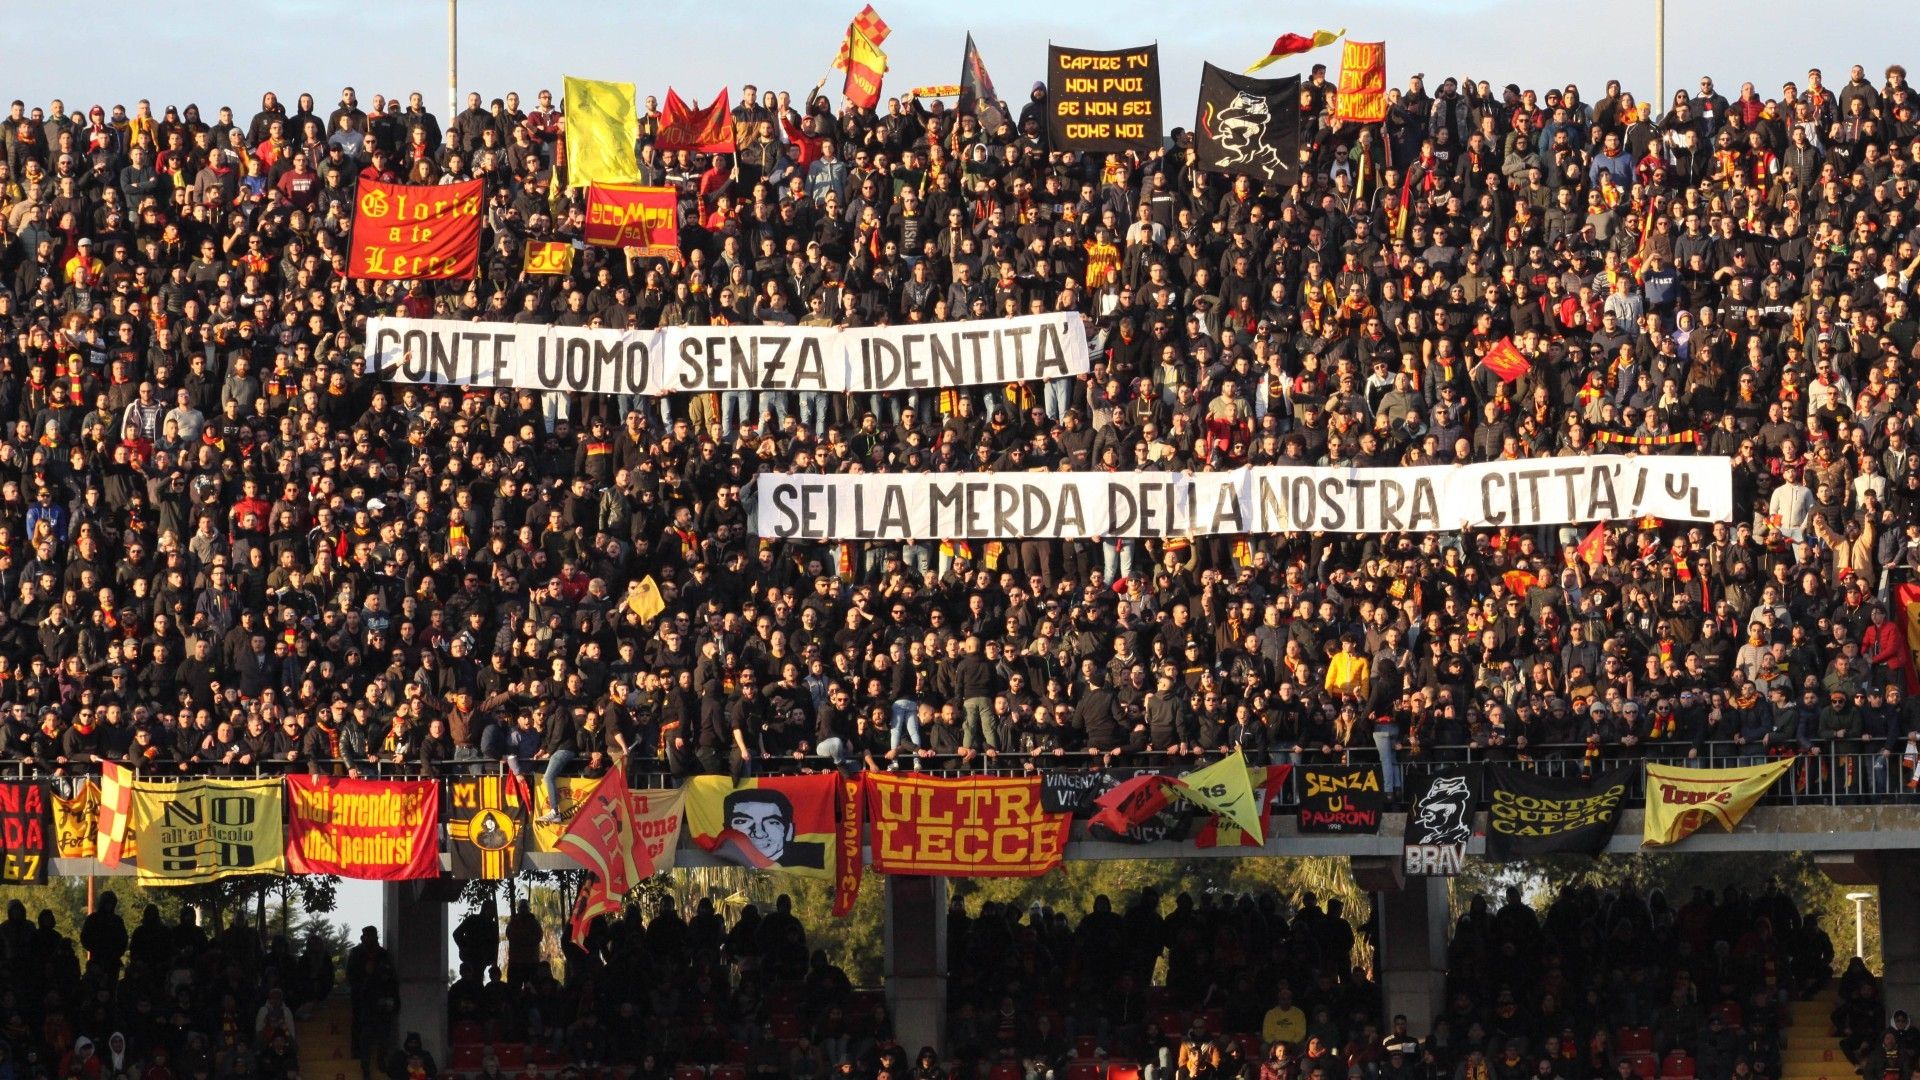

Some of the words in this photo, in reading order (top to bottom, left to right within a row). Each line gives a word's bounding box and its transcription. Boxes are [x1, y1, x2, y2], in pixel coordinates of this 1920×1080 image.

[1060, 54, 1120, 70] CAPIRE
[1344, 42, 1370, 69] SOLO
[1065, 78, 1098, 93] NON
[1058, 101, 1080, 116] SE
[1085, 101, 1117, 116] NON
[1123, 101, 1152, 116] SEI
[1338, 93, 1385, 119] BAMBINO
[1066, 124, 1110, 138] COME
[1115, 124, 1144, 138] NOI
[361, 188, 479, 221] Gloria
[389, 226, 401, 243] a
[411, 224, 432, 243] te
[375, 327, 516, 388] CONTE
[538, 336, 649, 395] UOMO
[680, 336, 827, 390] SENZA
[861, 321, 1069, 390] IDENTITA'
[773, 483, 836, 538] SEI
[855, 483, 912, 538] LA
[929, 482, 1087, 538] MERDA
[1108, 482, 1243, 538] DELLA
[1260, 475, 1440, 532] NOSTRA
[1664, 472, 1711, 518] UL
[1305, 769, 1380, 797] SENZA
[159, 794, 255, 828] NO
[297, 785, 329, 823] mai
[331, 786, 424, 828] arrendersi
[1328, 795, 1355, 812] UL
[1491, 796, 1620, 823] QUESTO
[1493, 784, 1626, 811] CONTRO
[1301, 809, 1377, 827] PADRONI
[1492, 810, 1613, 836] CALCIO
[161, 823, 254, 844] all'articolo
[841, 782, 858, 909] PESSIMI
[877, 821, 1063, 863] LECCE
[304, 827, 338, 864] mai
[340, 830, 414, 869] pentirsi
[1405, 842, 1468, 874] BRAV
